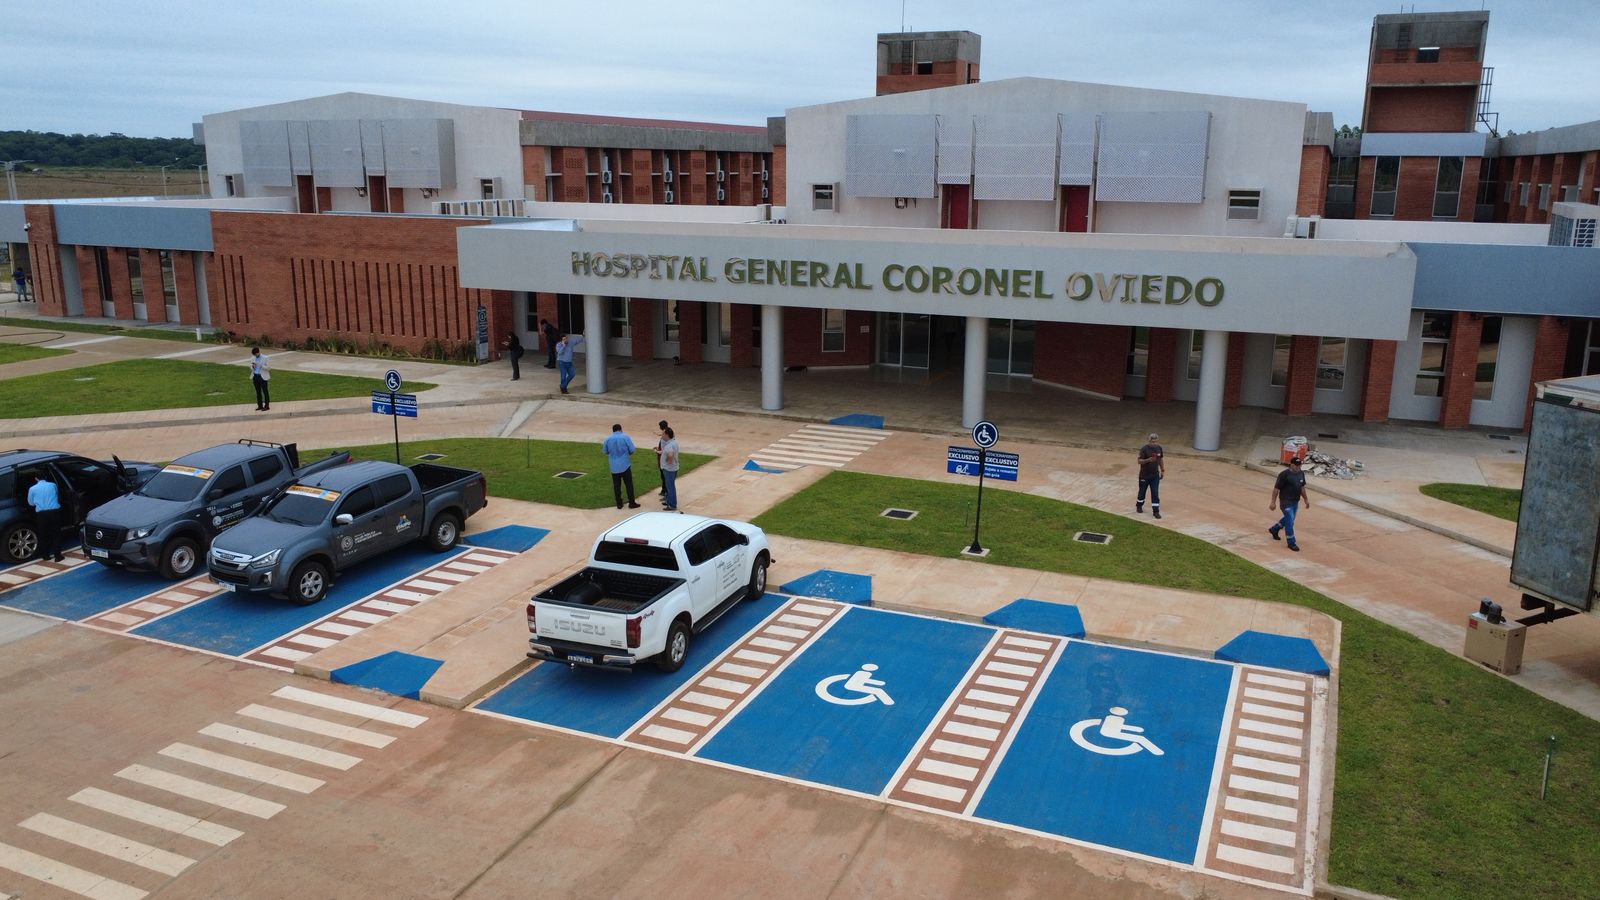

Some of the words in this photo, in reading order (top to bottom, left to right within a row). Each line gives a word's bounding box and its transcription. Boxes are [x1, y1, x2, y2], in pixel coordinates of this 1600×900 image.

[571, 250, 716, 283] HOSPITAL
[724, 256, 873, 291] GENERAL
[882, 263, 1054, 299] CORONEL
[1065, 271, 1225, 307] OVIEDO
[948, 452, 980, 461] EXCLUSIVO
[984, 457, 1018, 466] EXCLUSIVO
[553, 618, 606, 636] ISUZU
